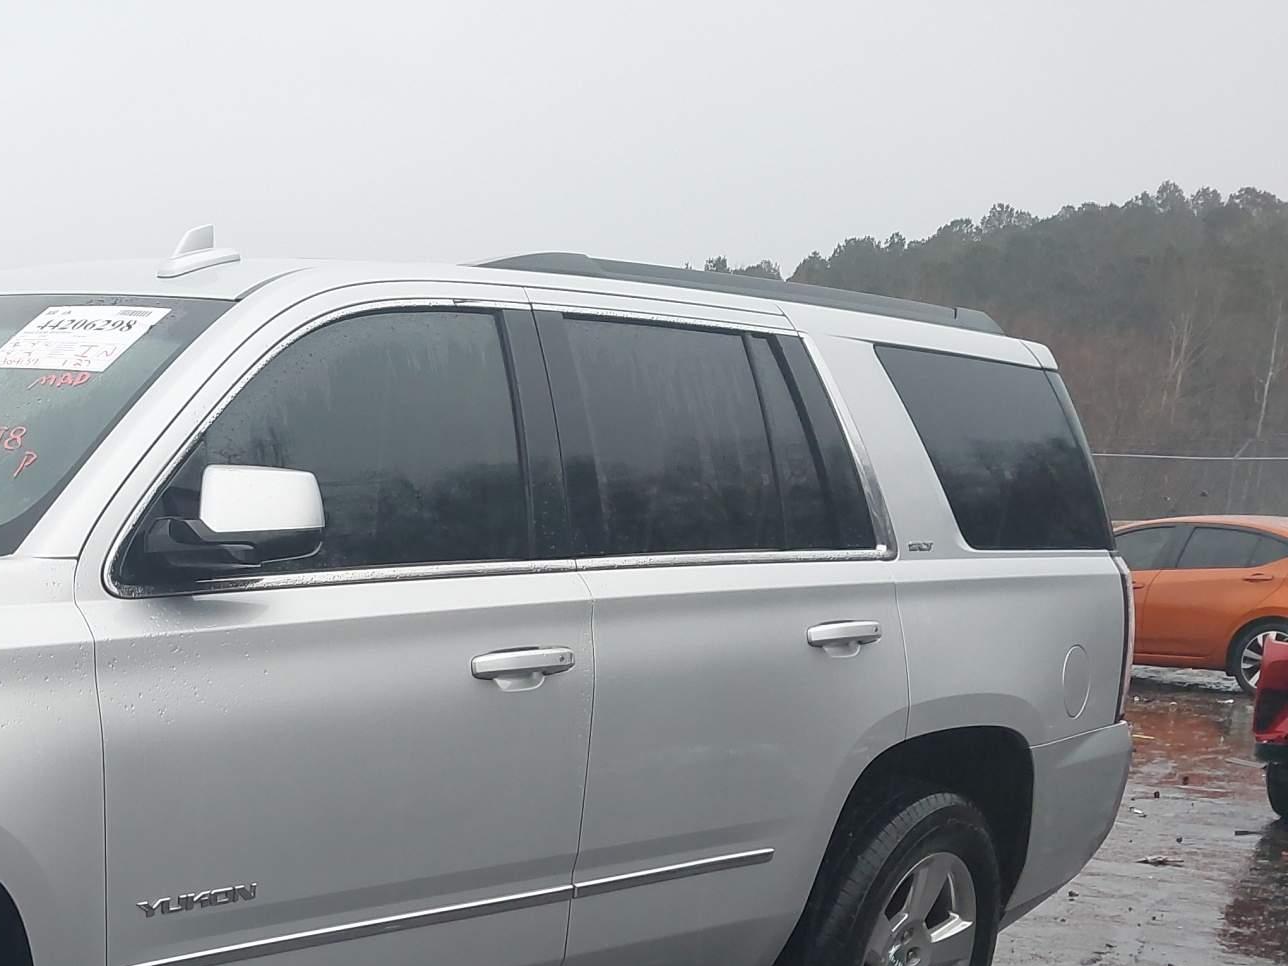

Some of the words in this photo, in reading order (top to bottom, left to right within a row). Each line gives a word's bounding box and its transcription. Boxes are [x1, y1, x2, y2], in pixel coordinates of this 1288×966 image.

[37, 318, 138, 333] 44206298
[908, 542, 934, 552] SLT
[136, 882, 257, 918] YUKON
